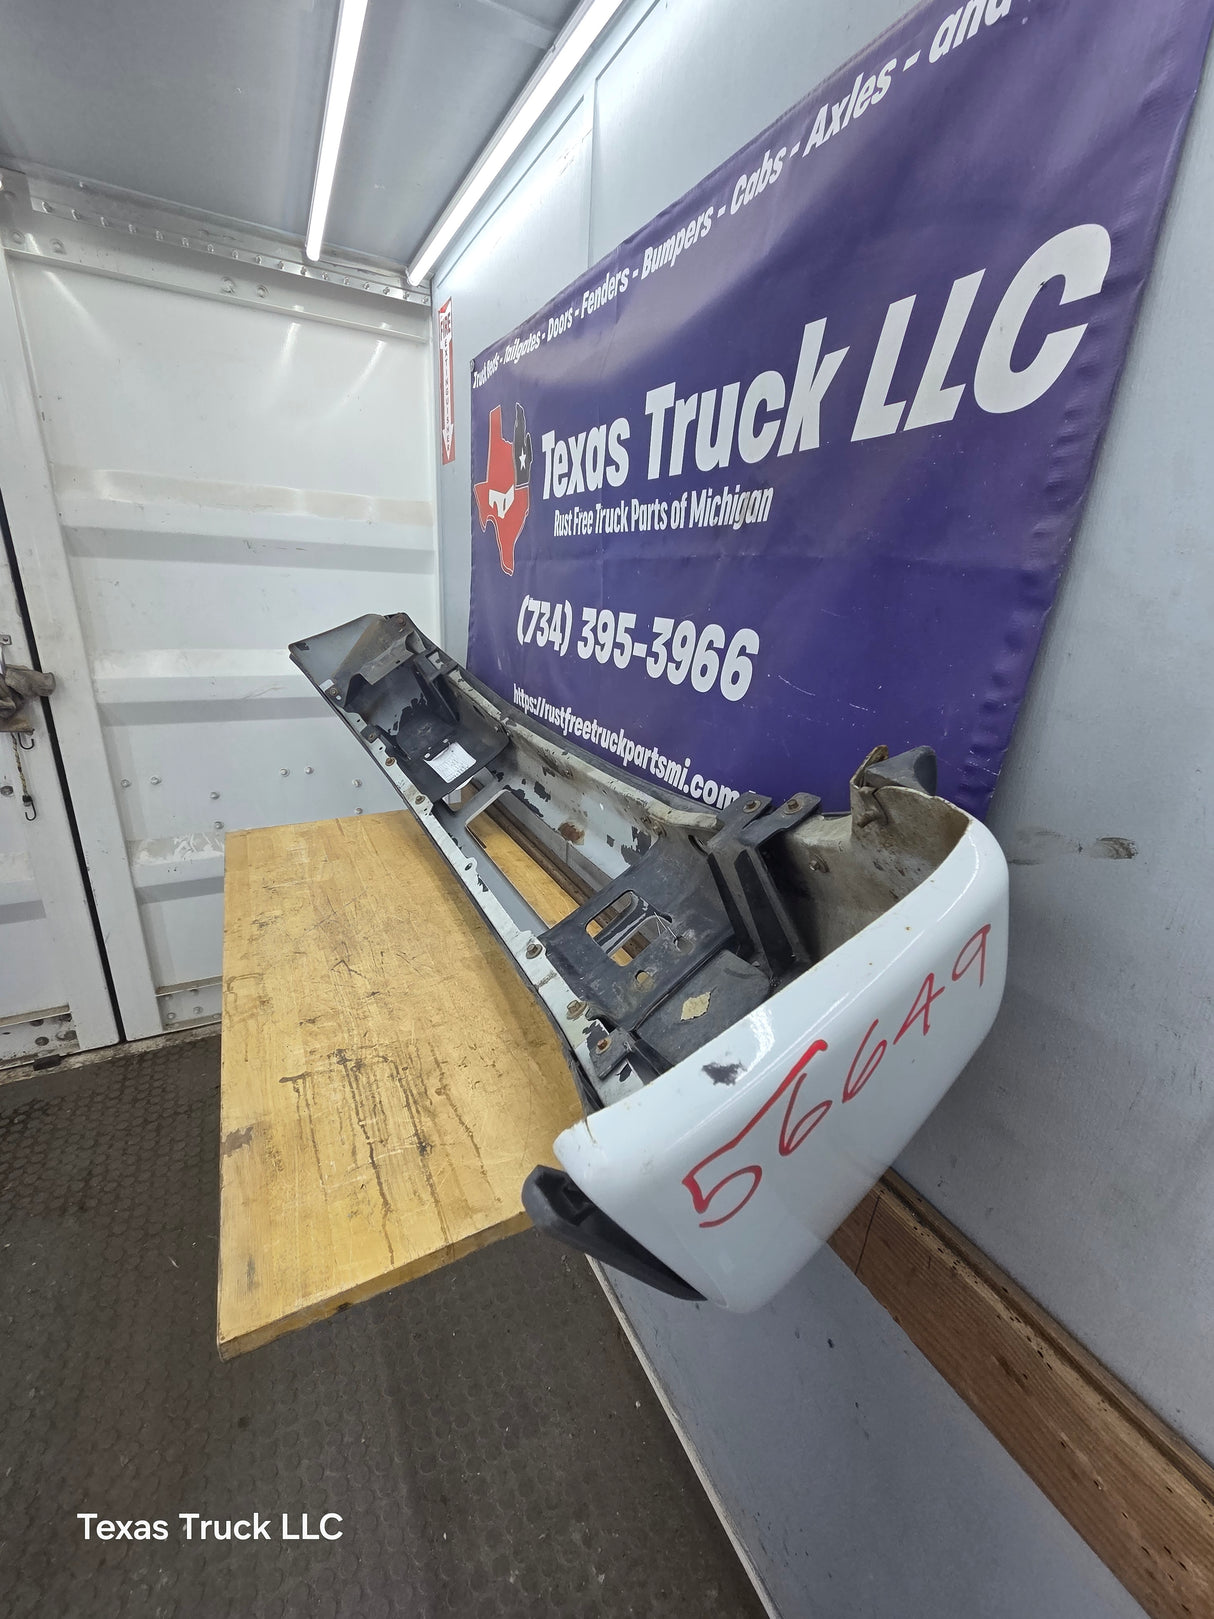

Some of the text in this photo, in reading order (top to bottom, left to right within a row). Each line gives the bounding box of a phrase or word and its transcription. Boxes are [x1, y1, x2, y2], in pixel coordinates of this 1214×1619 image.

[503, 330, 541, 365] Tailgates
[547, 306, 574, 342] Doors
[581, 267, 630, 319] Fenders
[641, 205, 714, 281] Bumpers
[731, 146, 788, 216] Cabs
[802, 57, 897, 158] Axles
[440, 311, 451, 341] FIRE
[541, 223, 1112, 500] Texas Truck LLC
[554, 484, 774, 537] Rust Free Truck Parts of Michigan
[516, 594, 761, 702] (734) 395-3966
[513, 683, 744, 810] https://rustfreetruckpartsmi.com
[681, 923, 992, 1229] 56649
